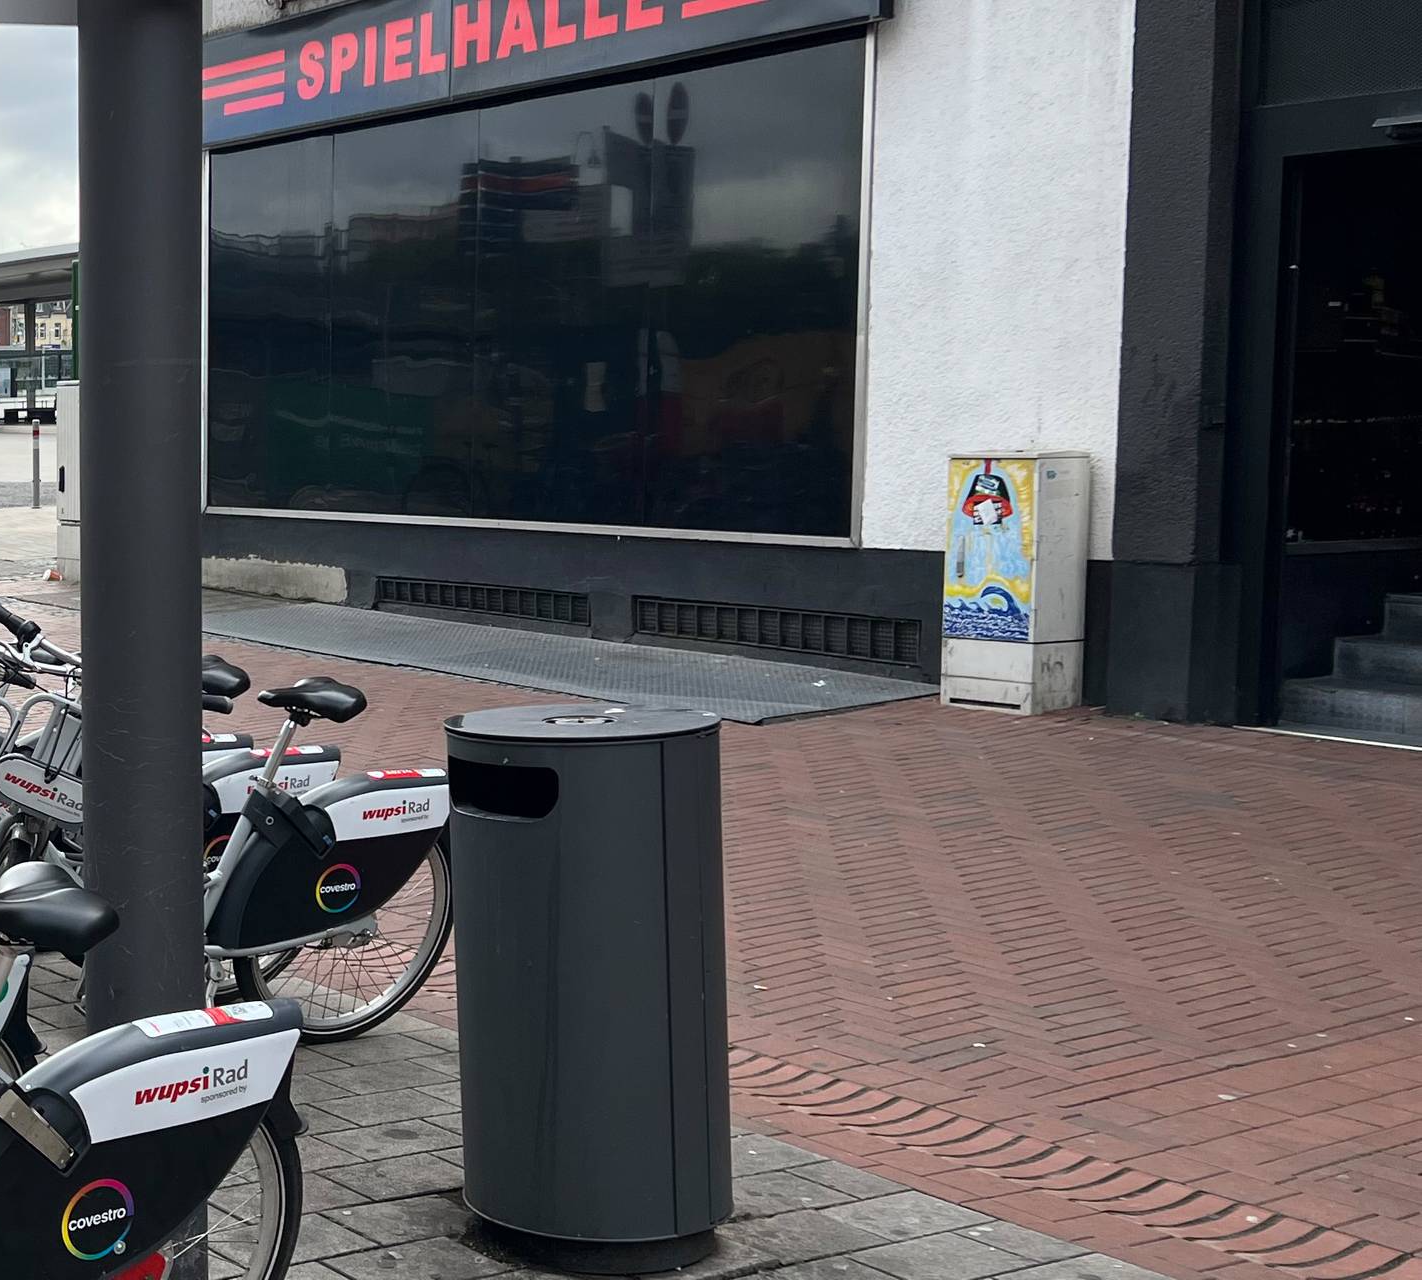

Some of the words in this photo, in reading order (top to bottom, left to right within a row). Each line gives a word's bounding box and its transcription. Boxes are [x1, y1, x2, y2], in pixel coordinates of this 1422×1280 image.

[297, 0, 664, 101] SPIELHALLE
[4, 772, 58, 801] wupsi
[289, 775, 310, 789] Rad
[362, 800, 406, 821] wupsi
[408, 799, 430, 815] Rad
[320, 882, 356, 894] covestro
[135, 1066, 210, 1106] wupsi
[213, 1059, 248, 1088] Rad
[201, 1087, 238, 1104] sponsored
[238, 1085, 247, 1094] by
[68, 1207, 126, 1231] covestro
